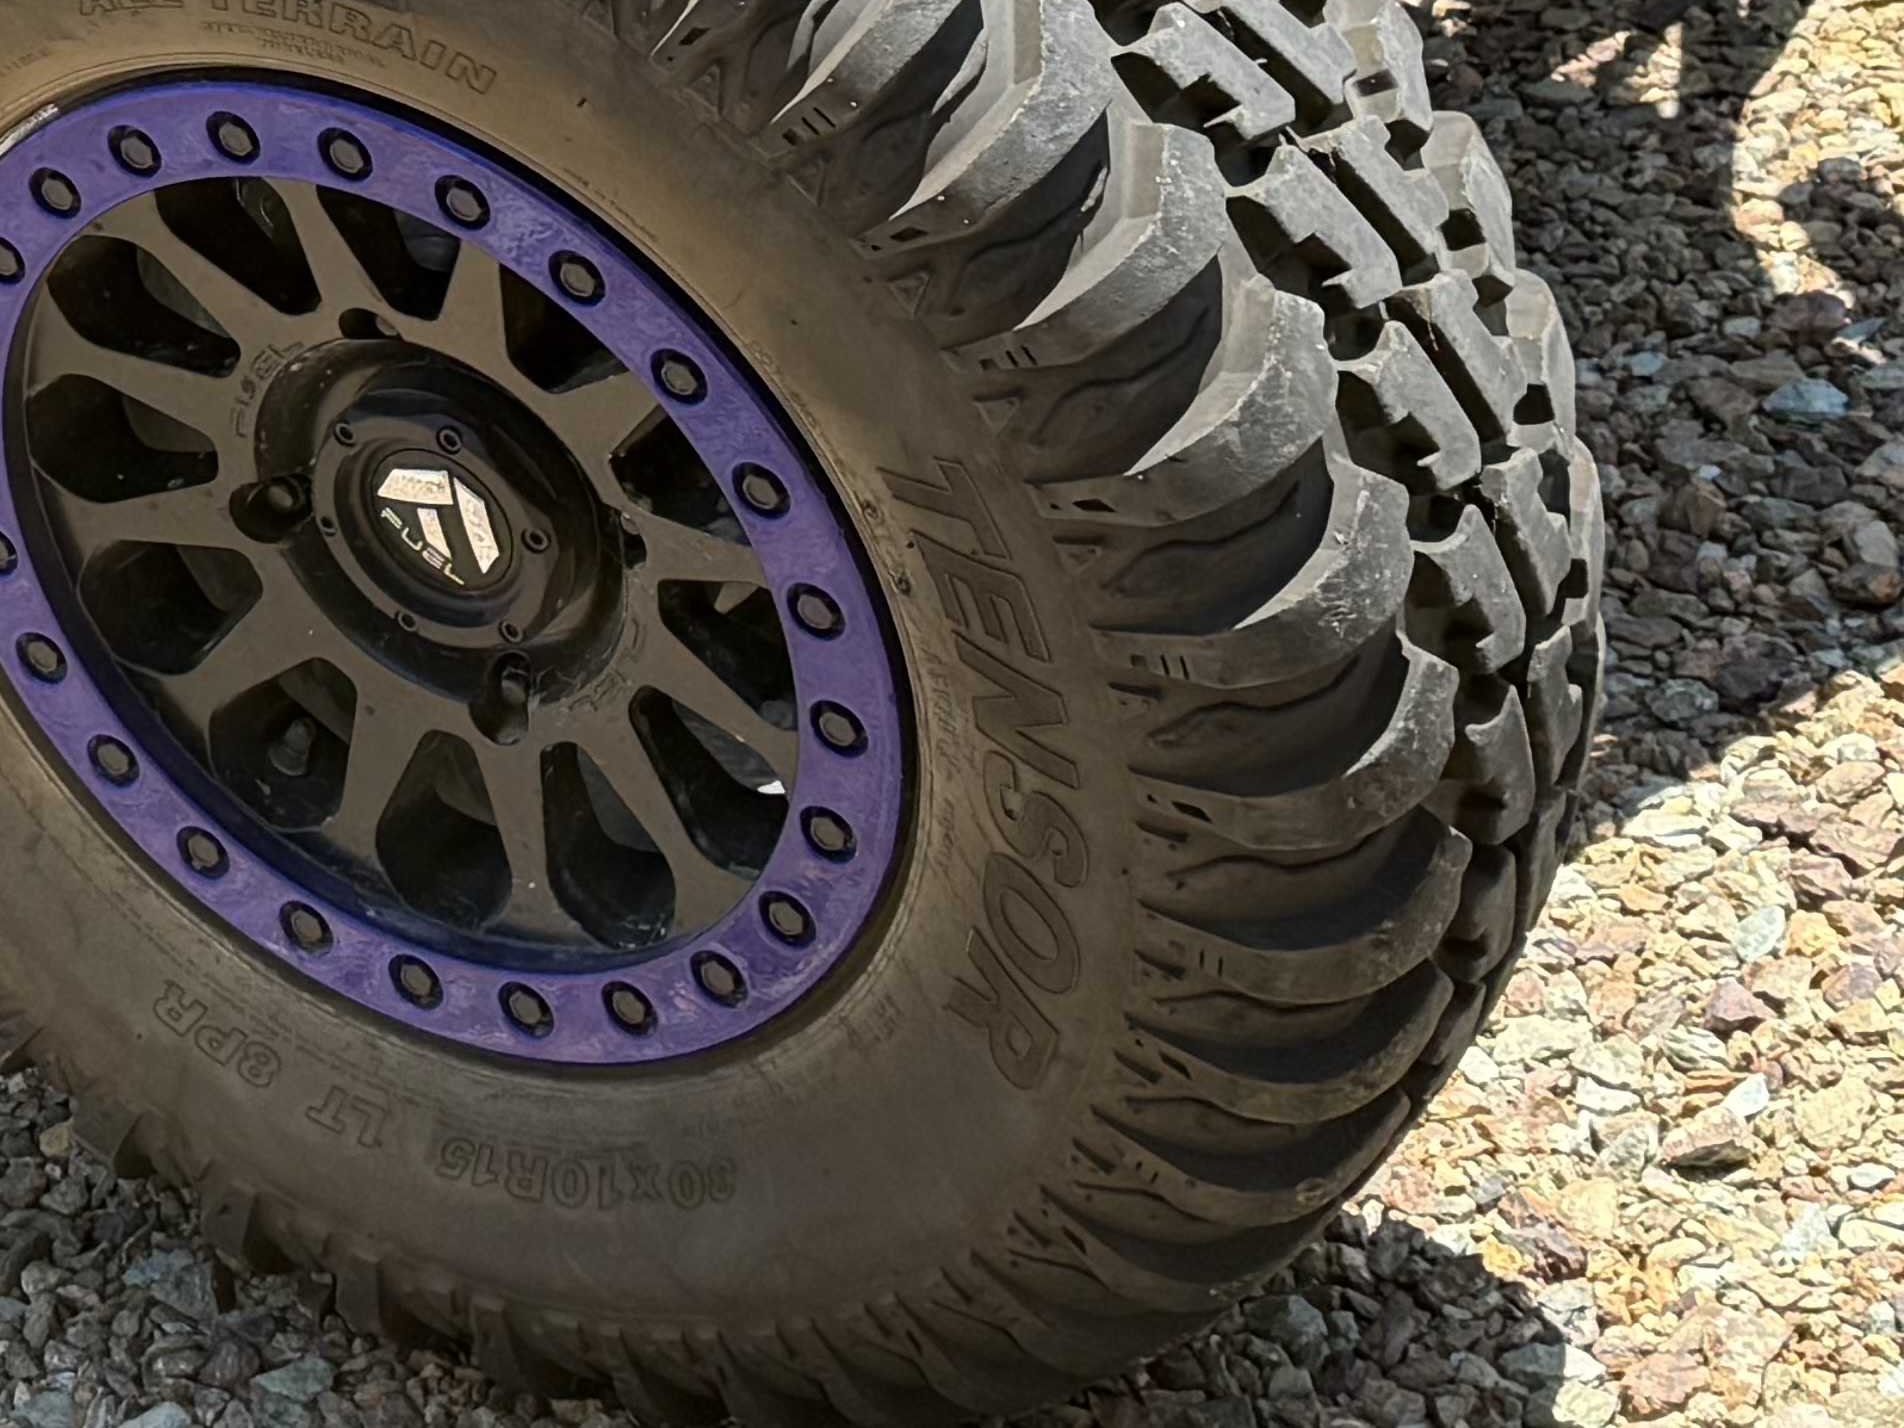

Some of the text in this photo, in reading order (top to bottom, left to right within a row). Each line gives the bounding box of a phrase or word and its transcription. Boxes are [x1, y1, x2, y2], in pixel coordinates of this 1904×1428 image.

[379, 506, 466, 587] FUEL
[875, 455, 1089, 1092] TENSOR
[152, 978, 284, 1091] 8PR
[306, 1083, 393, 1149] LT
